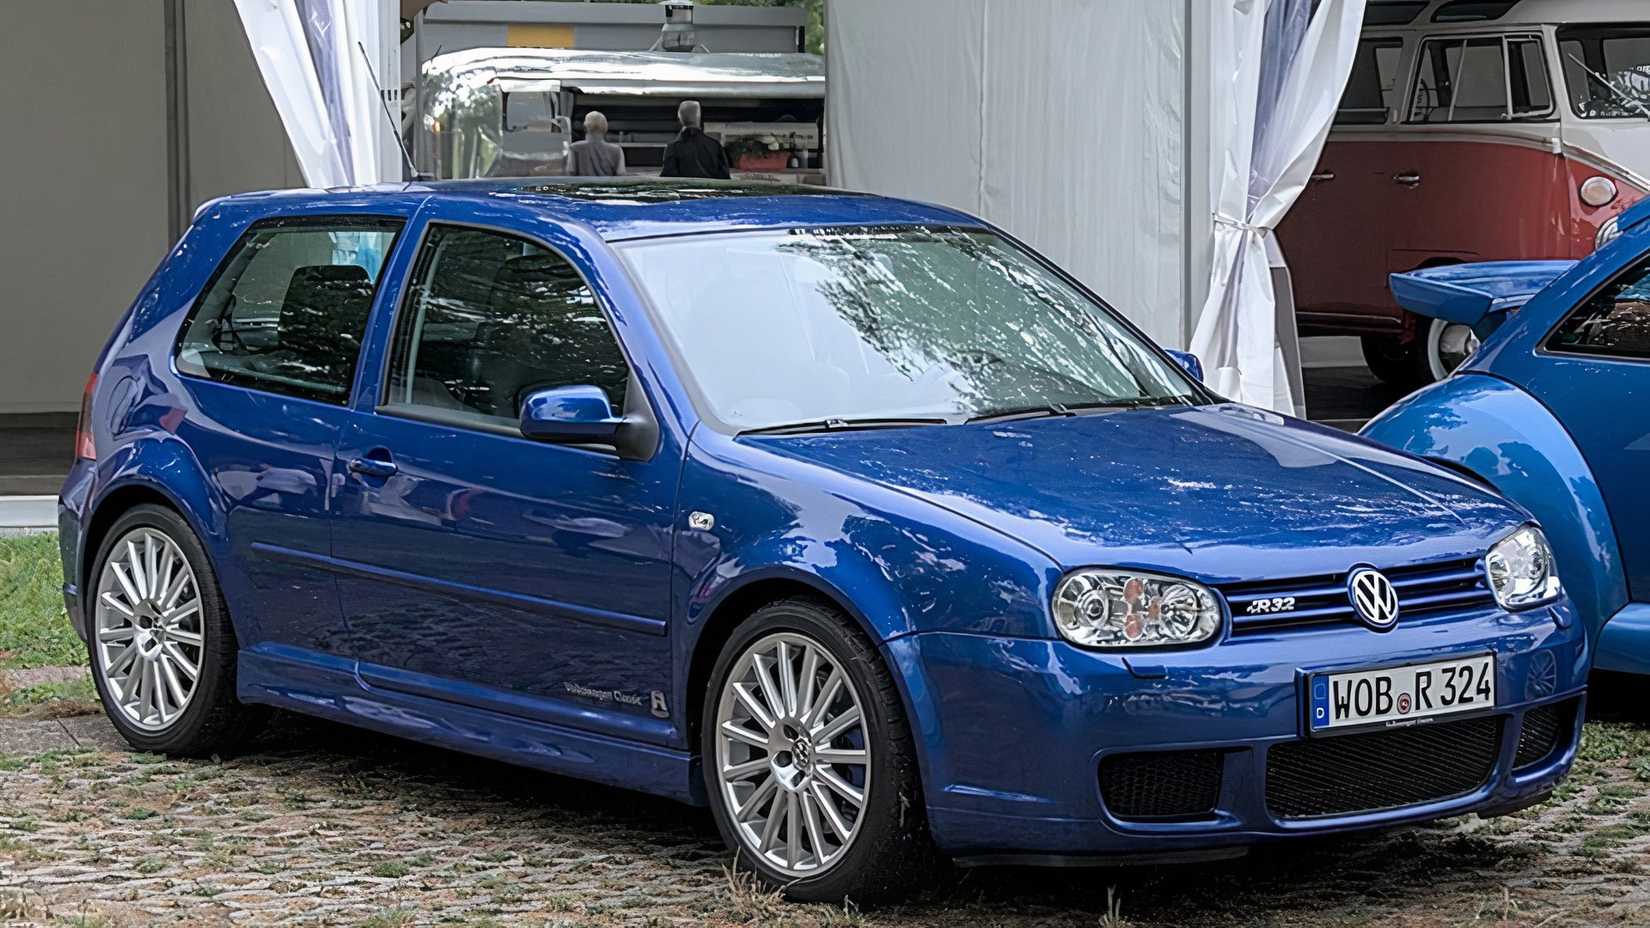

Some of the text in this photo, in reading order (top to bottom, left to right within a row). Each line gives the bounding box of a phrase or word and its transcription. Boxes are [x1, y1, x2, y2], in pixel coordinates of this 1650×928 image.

[1246, 596, 1296, 614] R32
[1332, 662, 1492, 720] WOB R 324
[1316, 706, 1325, 719] D
